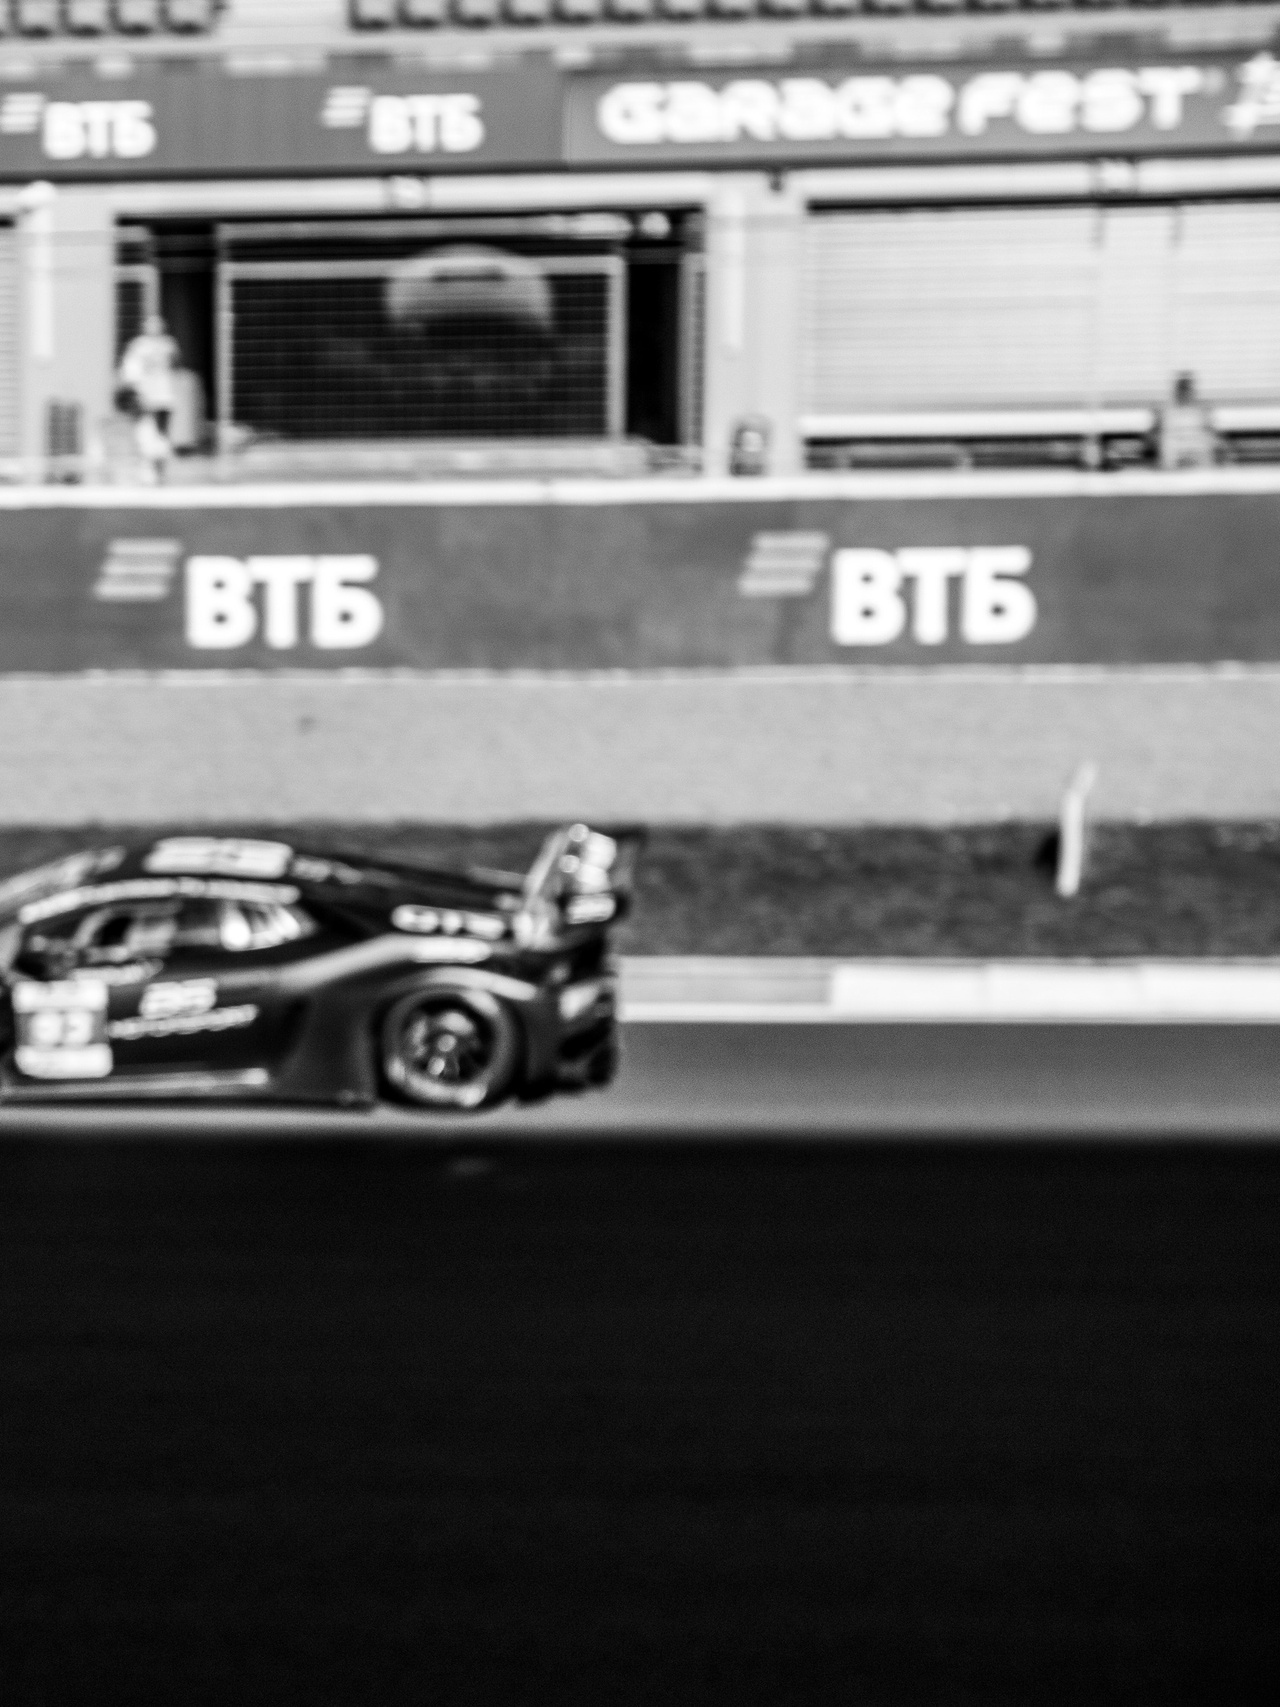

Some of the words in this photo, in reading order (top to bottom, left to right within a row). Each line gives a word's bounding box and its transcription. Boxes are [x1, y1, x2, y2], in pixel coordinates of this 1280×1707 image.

[42, 98, 155, 158] ВТБ
[368, 94, 483, 152] ВТБ
[188, 556, 381, 647] ВТБ
[833, 548, 1034, 644] ВТБ
